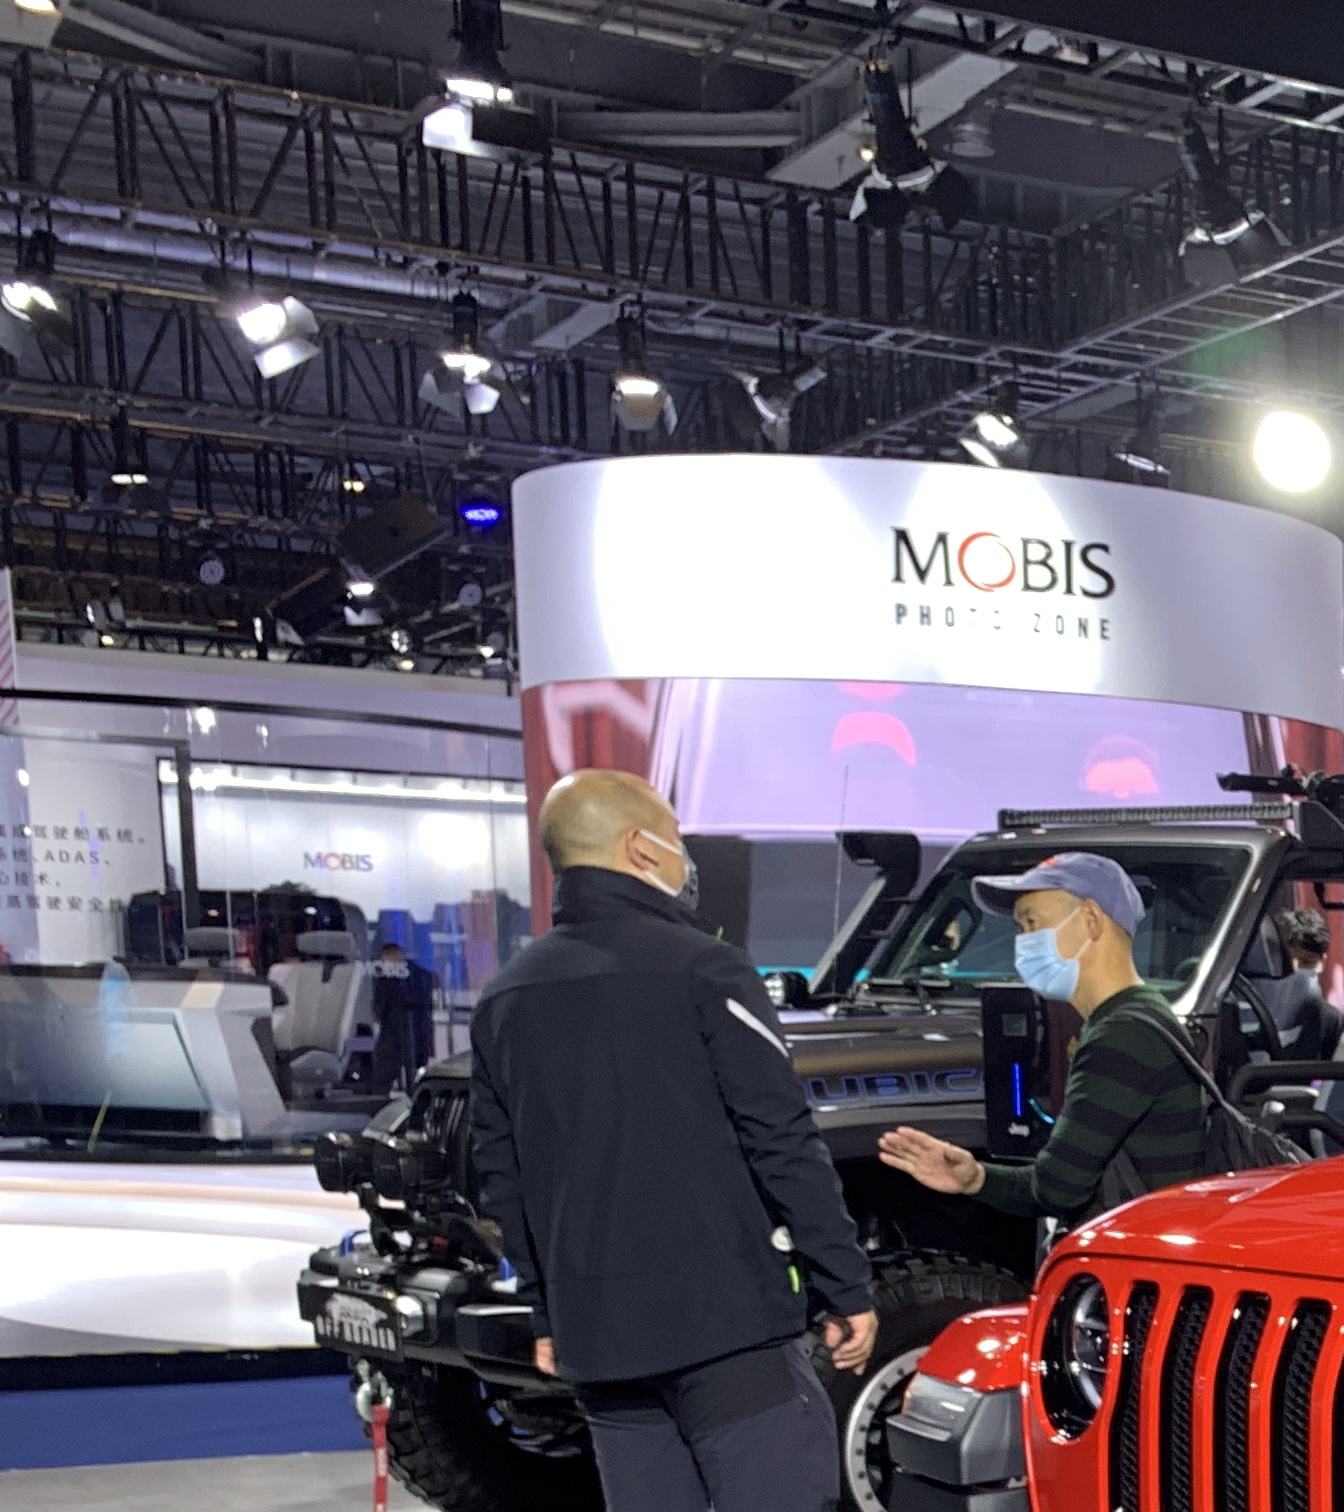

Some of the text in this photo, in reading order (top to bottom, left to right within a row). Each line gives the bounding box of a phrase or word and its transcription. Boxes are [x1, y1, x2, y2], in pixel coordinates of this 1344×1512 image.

[891, 526, 1116, 600] MOBIS
[1033, 611, 1111, 641] ZONE
[303, 851, 374, 872] MOBIS
